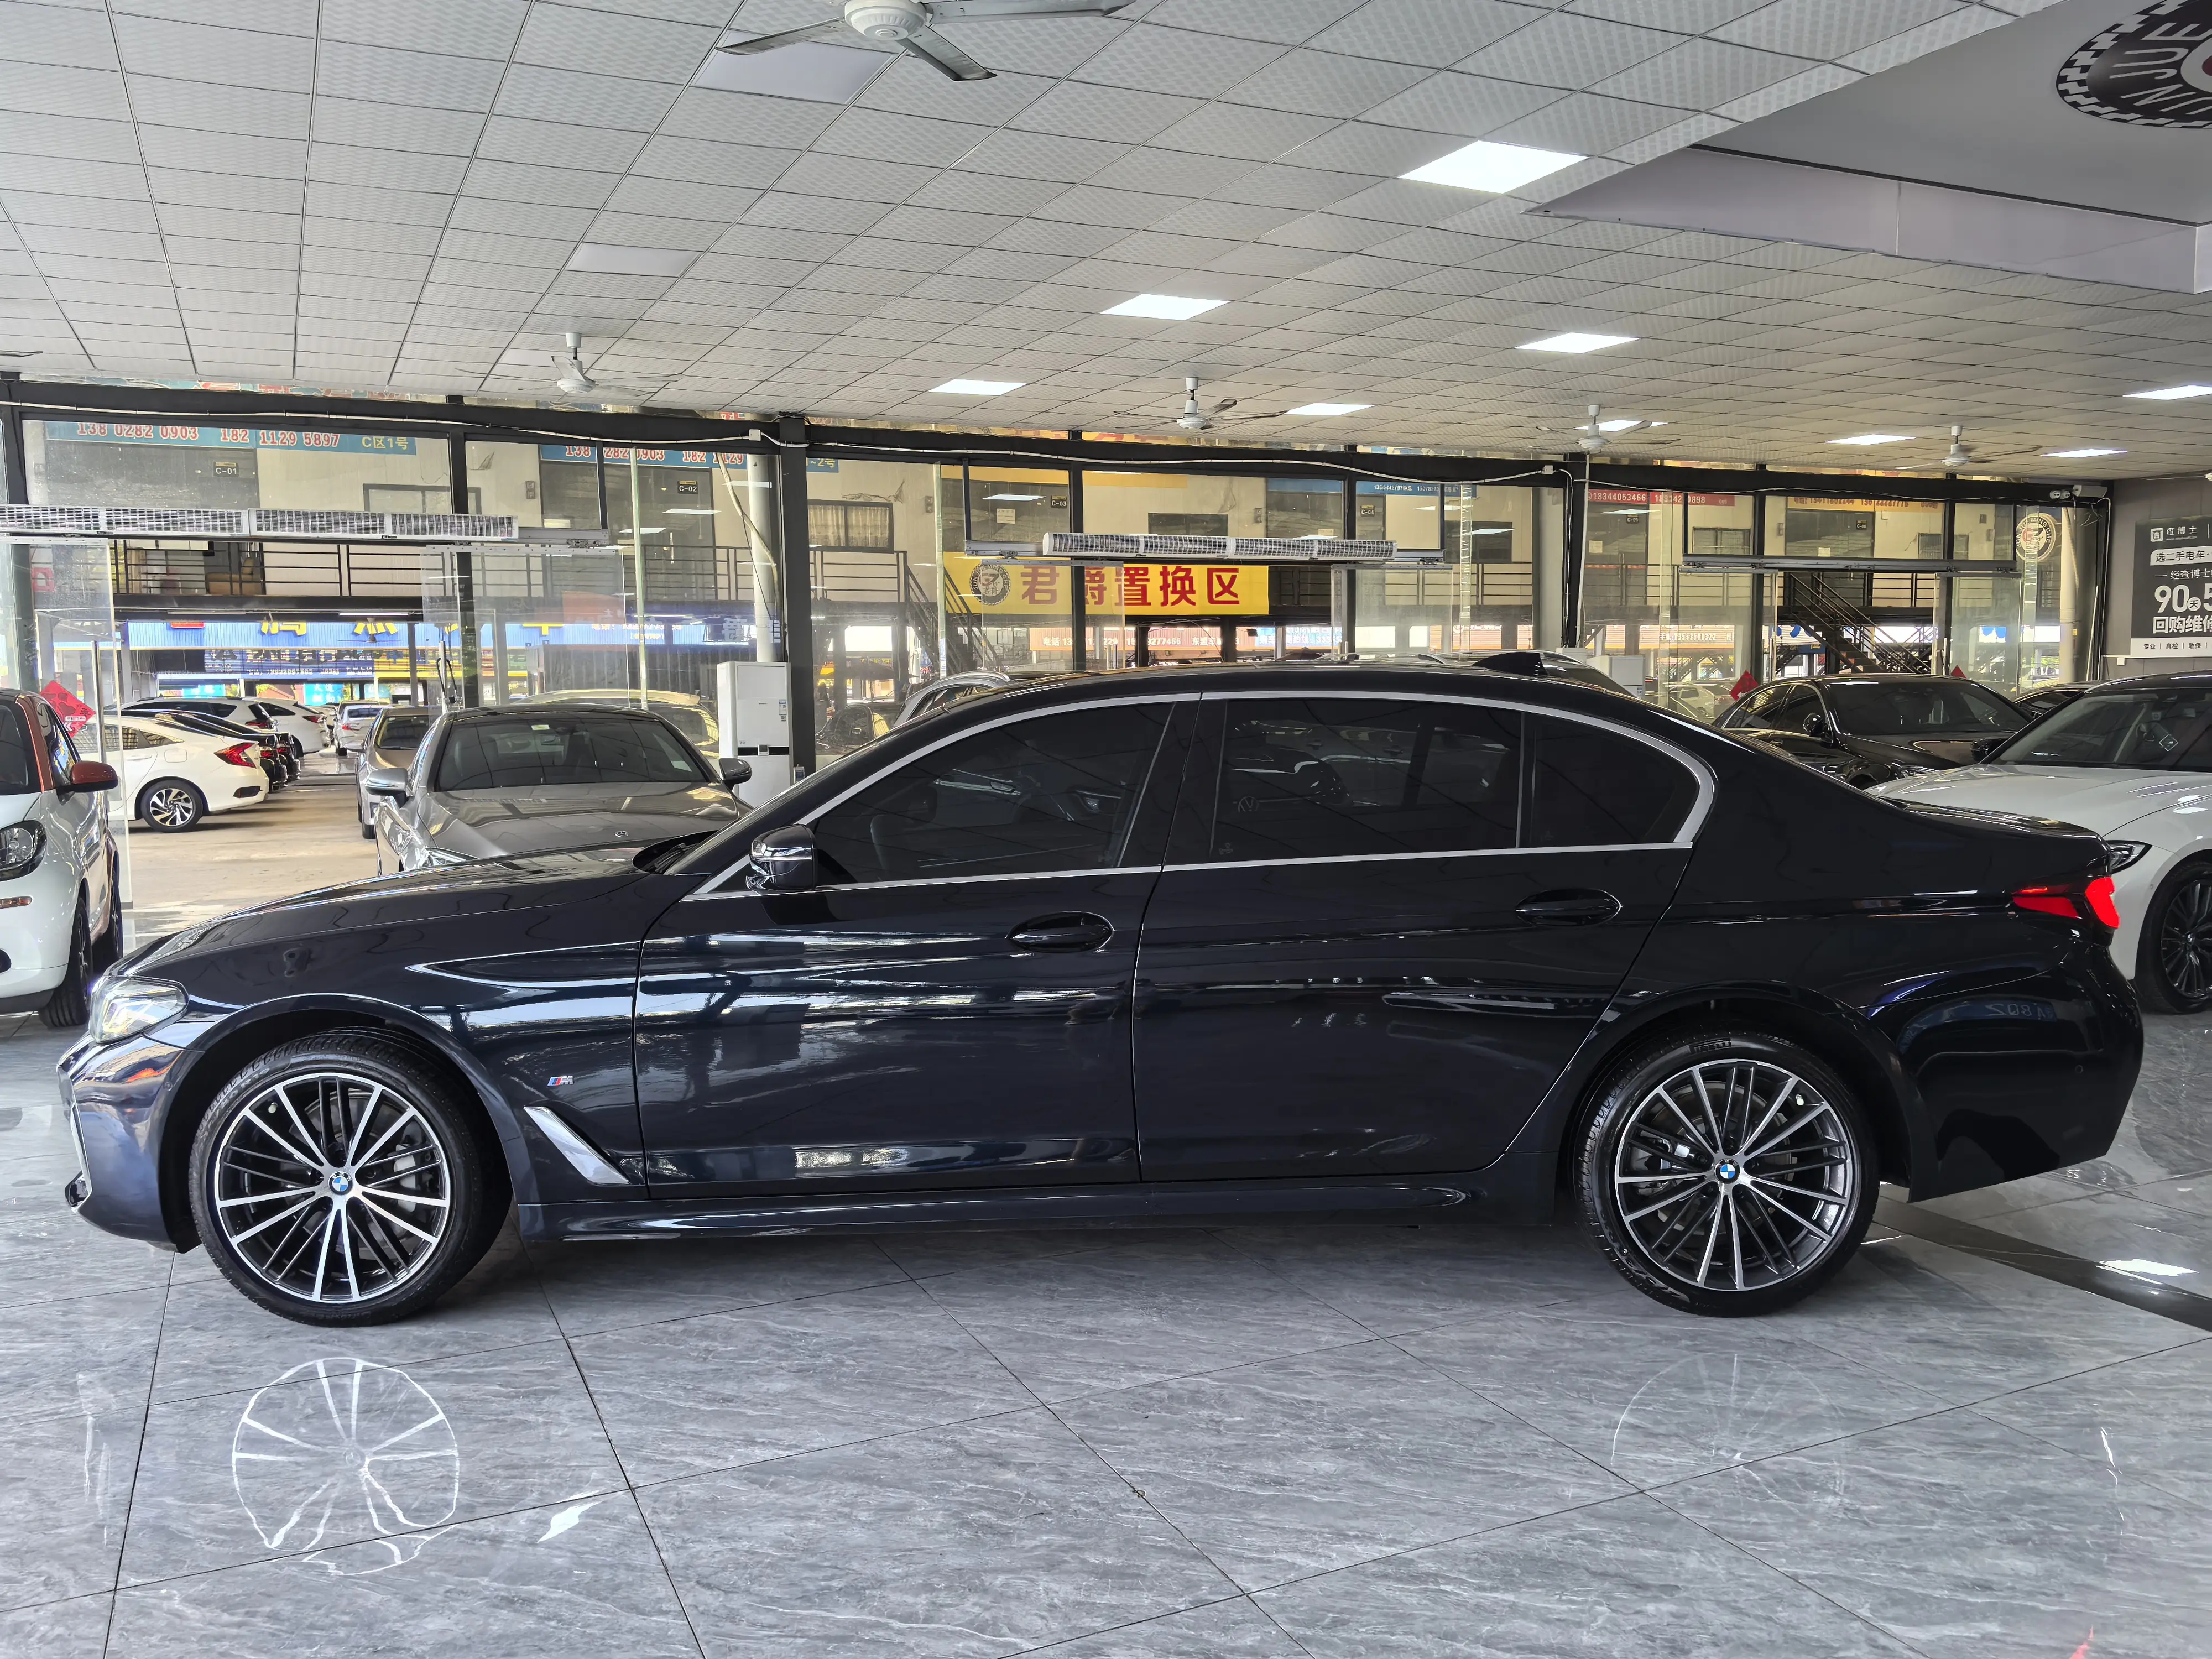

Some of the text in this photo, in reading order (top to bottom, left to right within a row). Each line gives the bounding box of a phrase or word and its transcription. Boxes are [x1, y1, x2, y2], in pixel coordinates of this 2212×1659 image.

[77, 422, 408, 450] 138 0282 0903 182 1129 5897 C区1号
[604, 448, 629, 458] 282
[1593, 492, 1646, 502] 18344053466
[2169, 568, 2212, 580] 经查博士
